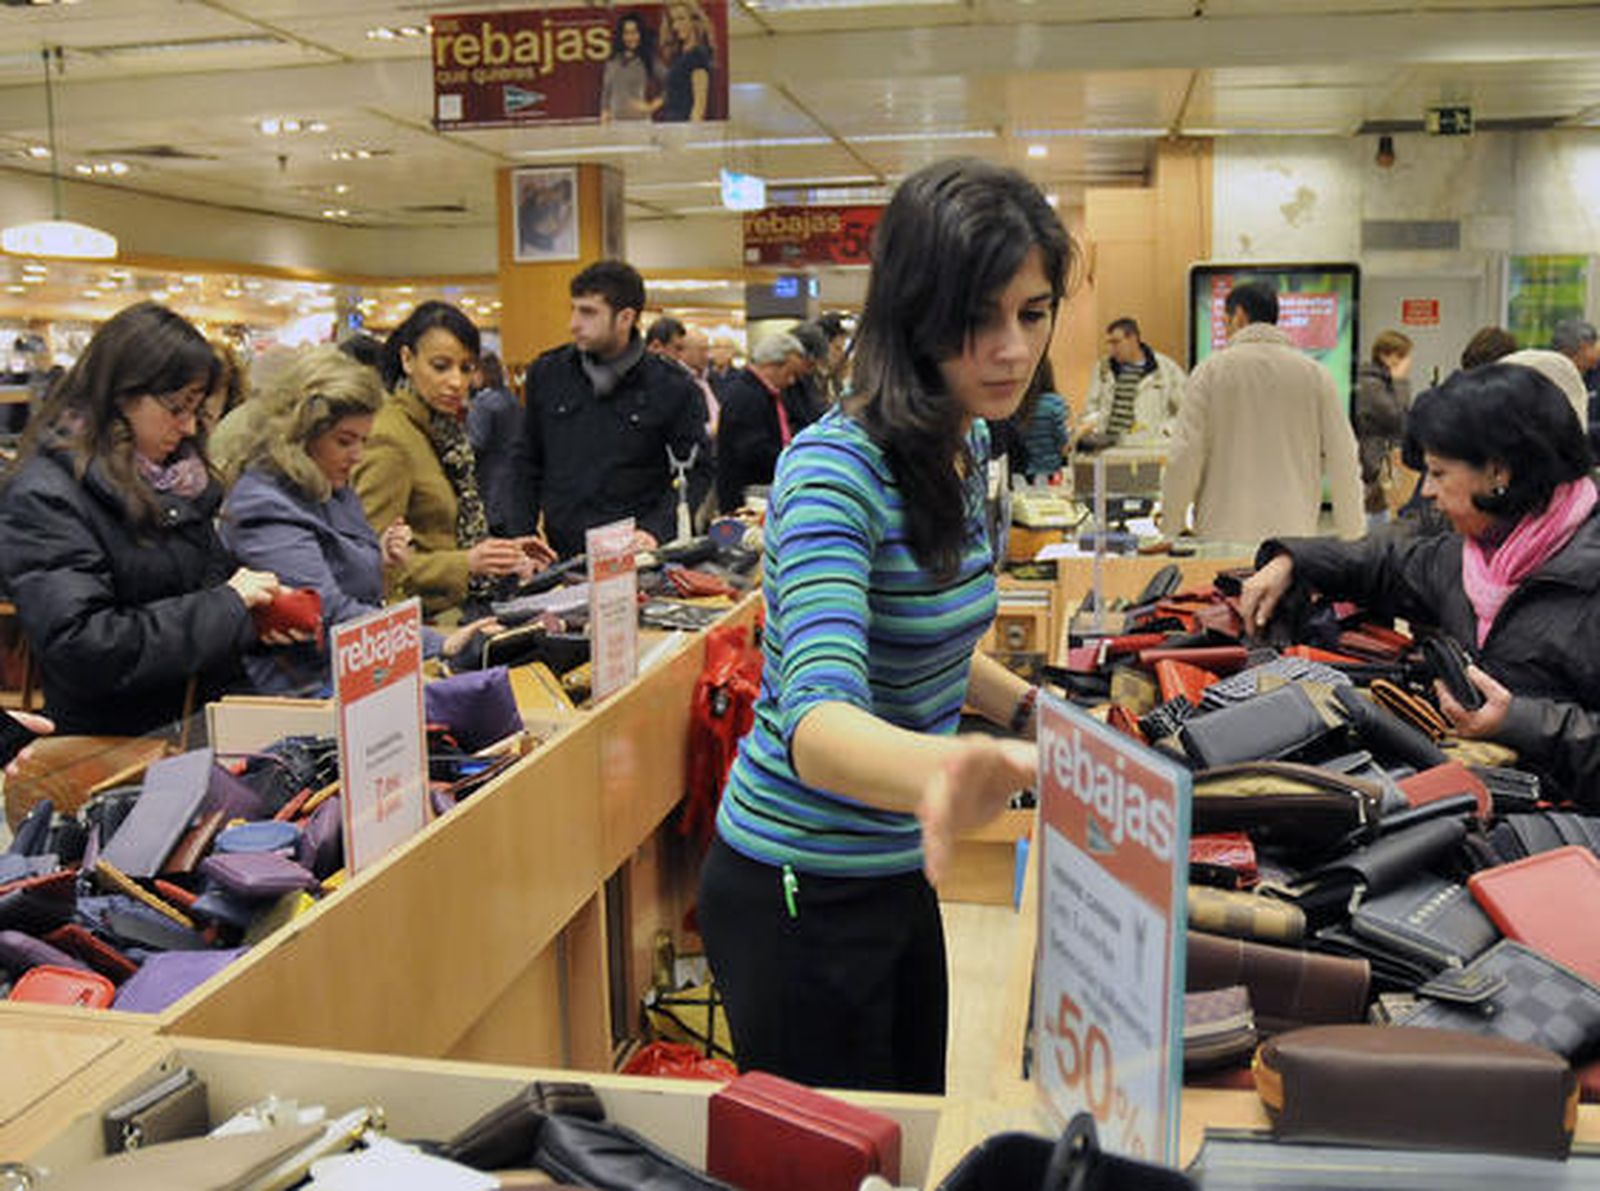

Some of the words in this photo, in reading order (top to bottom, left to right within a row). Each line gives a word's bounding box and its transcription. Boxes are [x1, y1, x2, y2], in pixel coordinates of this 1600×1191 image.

[434, 19, 612, 75] rebajas
[744, 211, 841, 239] rebajas
[339, 616, 419, 676] rebajas
[1042, 727, 1173, 862] rebajas
